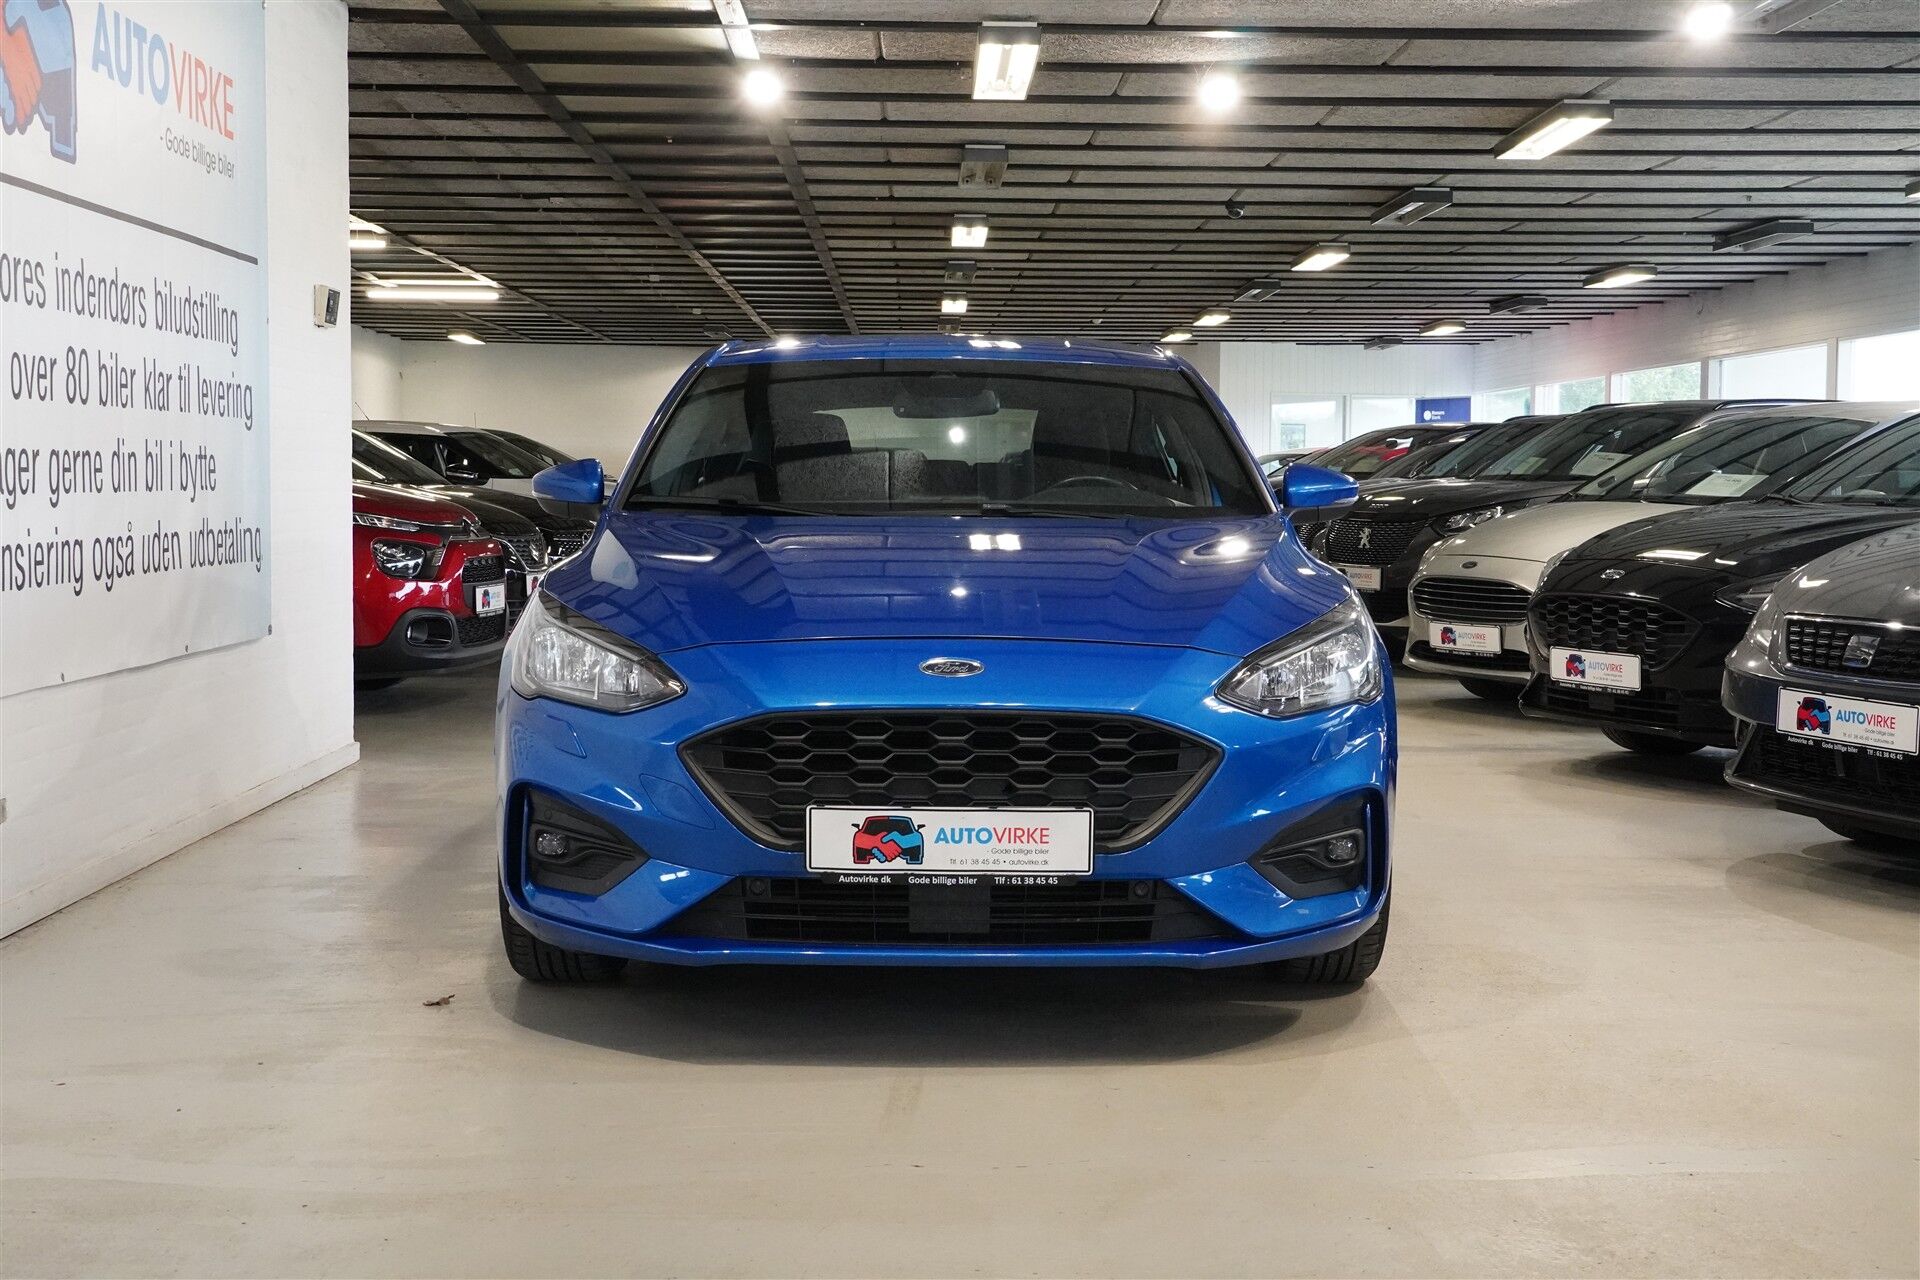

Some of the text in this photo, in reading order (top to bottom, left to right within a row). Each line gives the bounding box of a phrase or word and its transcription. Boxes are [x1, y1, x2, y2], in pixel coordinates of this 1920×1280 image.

[92, 2, 234, 140] AUTOVIRKE
[166, 128, 190, 159] Gode
[192, 139, 216, 174] billige
[218, 152, 235, 179] biler
[55, 252, 147, 328] indendørs
[154, 277, 238, 357] biludstilling
[11, 346, 252, 430] over 80 biler klar til levering
[49, 448, 103, 508] gerne
[111, 438, 137, 493] din
[145, 439, 162, 492] bil
[170, 440, 173, 491] i
[180, 440, 216, 502] bytte
[93, 521, 134, 592] også
[142, 520, 182, 574] uden
[190, 517, 262, 573] udbetaling
[1458, 632, 1486, 640] AUTOVIRKE
[1588, 661, 1623, 673] AUTOVIRKE
[1836, 709, 1896, 730] AUTOVIRKE
[934, 827, 1050, 844] AUTOVIRKE
[1013, 847, 1033, 856] billige
[1035, 847, 1049, 855] biler
[839, 874, 879, 883] Autovirke
[908, 876, 930, 884] Gode
[932, 876, 957, 885] billige
[959, 876, 977, 884] biler
[994, 876, 1005, 884] Tlf
[1012, 876, 1021, 884] 61
[1023, 876, 1034, 884] 38
[1036, 876, 1046, 884] 45
[1048, 876, 1058, 884] 45
